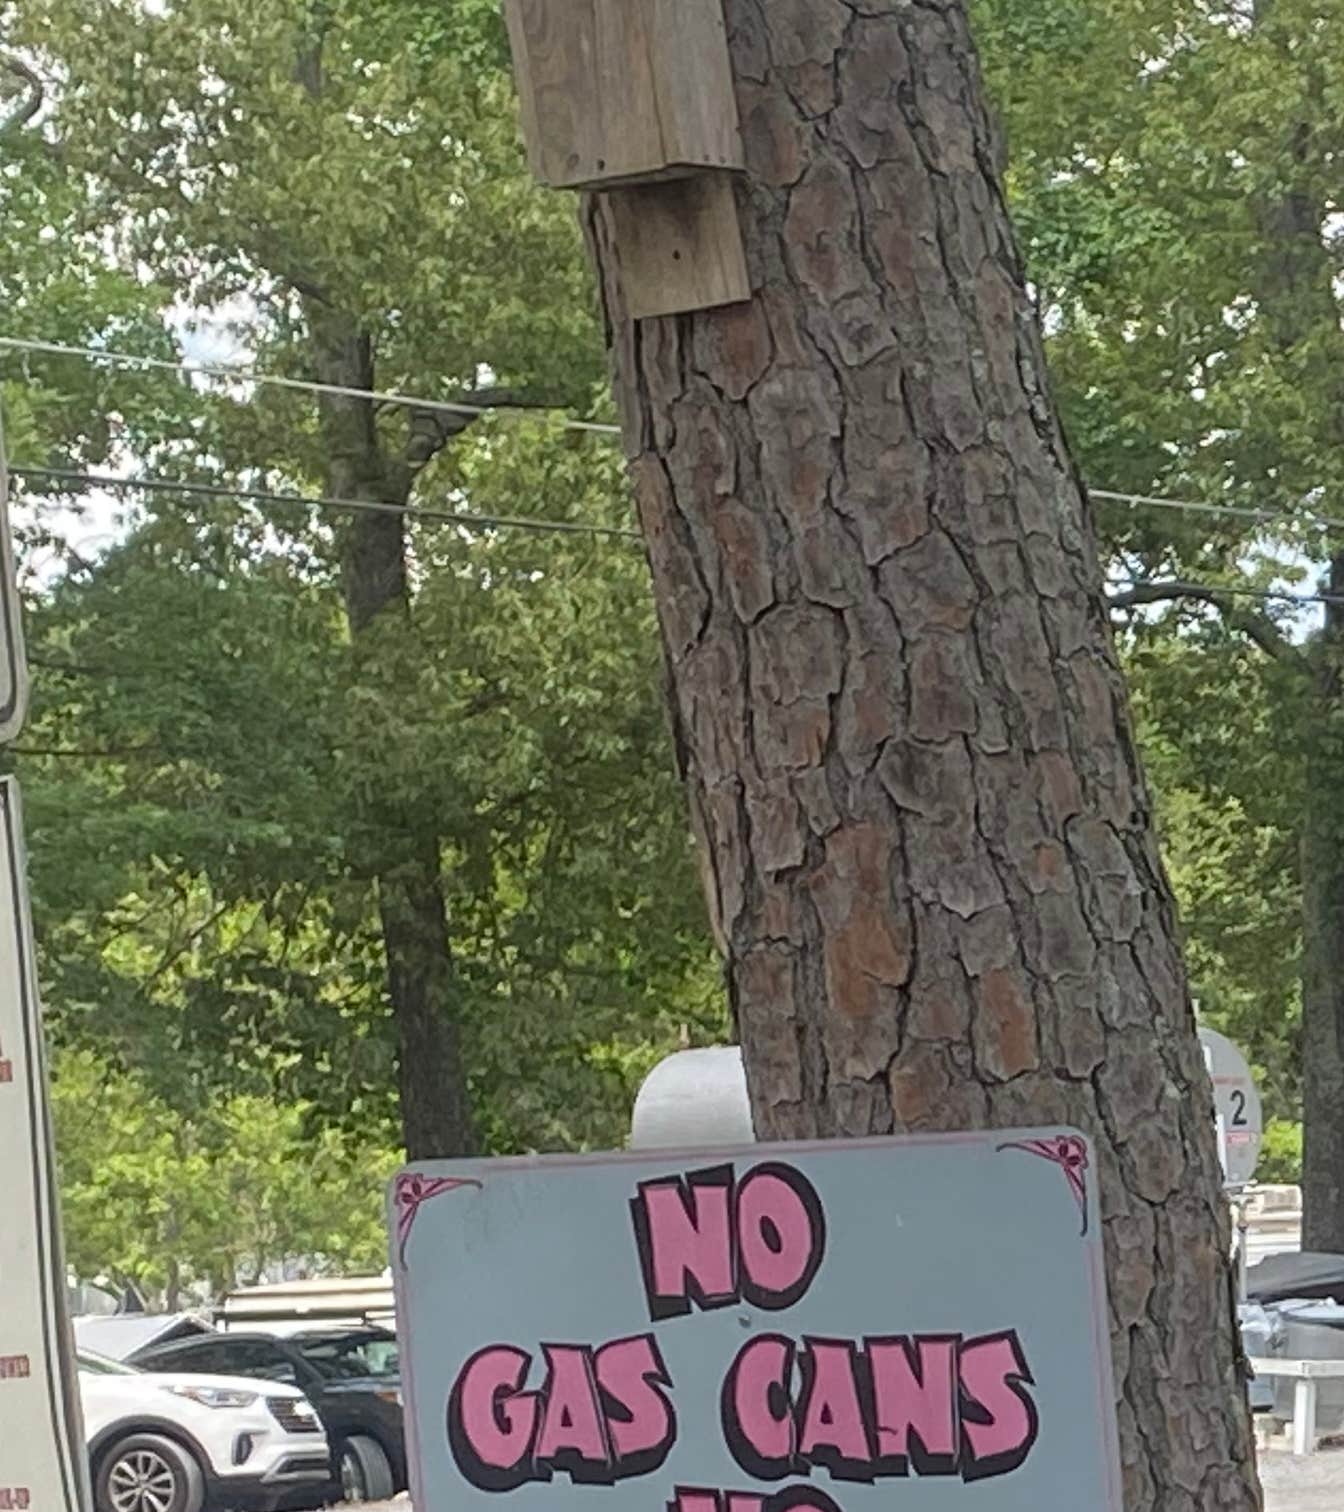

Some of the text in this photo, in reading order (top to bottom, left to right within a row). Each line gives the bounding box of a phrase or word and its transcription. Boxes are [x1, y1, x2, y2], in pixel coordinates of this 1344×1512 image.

[1230, 1089, 1247, 1126] 2
[630, 1161, 827, 1321] NO
[447, 1329, 1038, 1493] GAS CANS
